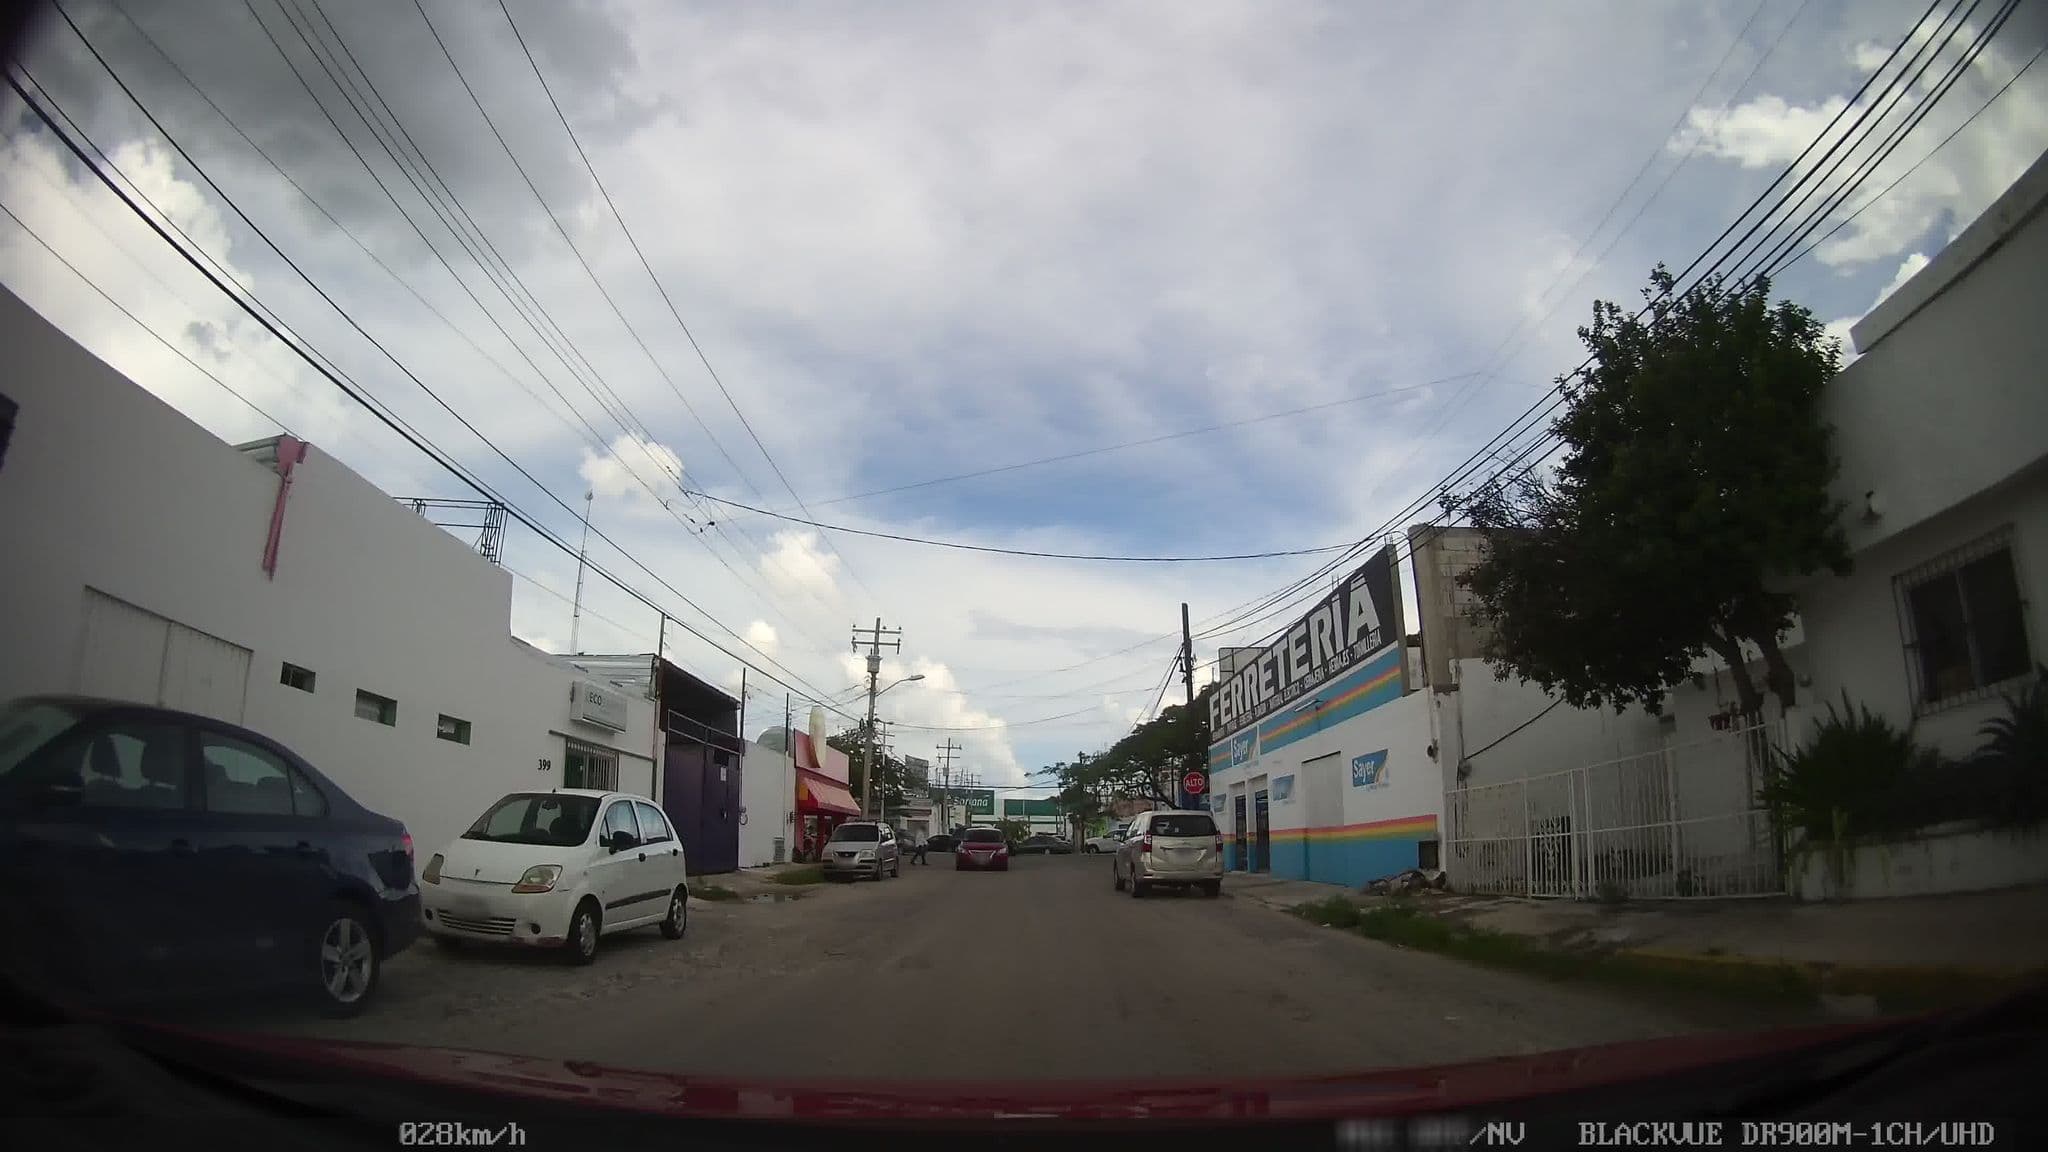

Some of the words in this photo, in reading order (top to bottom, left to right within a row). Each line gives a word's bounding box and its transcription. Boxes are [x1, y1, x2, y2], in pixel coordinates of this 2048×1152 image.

[1209, 572, 1381, 733] FERRETERIA
[537, 758, 552, 771] 399
[1353, 758, 1376, 783] Sayer
[1185, 778, 1204, 787] ALTO
